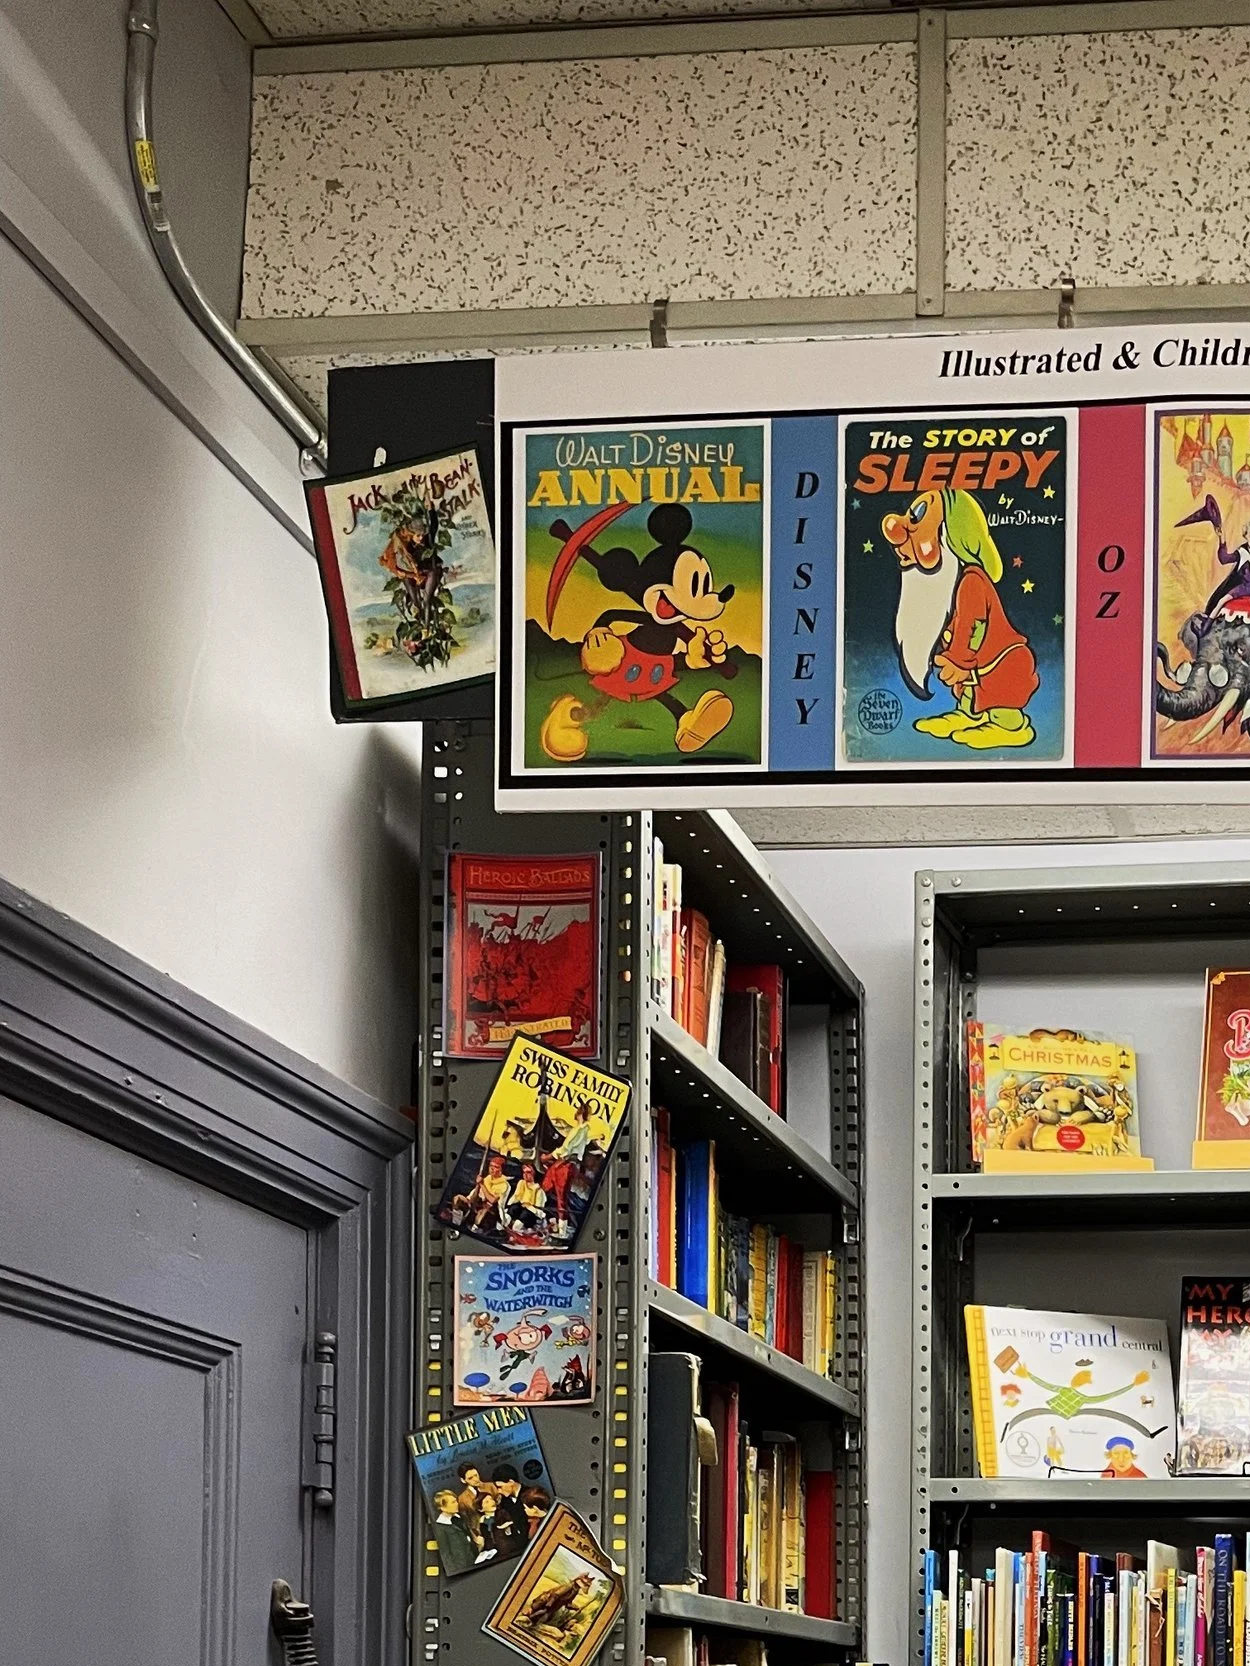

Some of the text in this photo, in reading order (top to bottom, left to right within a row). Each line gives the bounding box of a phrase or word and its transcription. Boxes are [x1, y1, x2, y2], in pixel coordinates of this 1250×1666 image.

[939, 343, 1101, 378] Illustrated
[1112, 342, 1141, 370] &
[555, 436, 624, 467] WALT
[869, 426, 1055, 449] The STORY of
[853, 450, 1060, 494] SLEEPY
[526, 466, 761, 508] ANNUAL
[998, 493, 1014, 509] by
[792, 471, 819, 725] DISNEY
[468, 864, 591, 889] HEROIC BALLADS
[1009, 1047, 1112, 1068] CHRISTMAS
[519, 1047, 624, 1104] SWISS FAMILY
[510, 1063, 616, 1124] ROBINSON
[484, 1266, 575, 1291] SNORKS
[1188, 1284, 1234, 1301] MY
[991, 1325, 1163, 1354] next stop grand central
[408, 1417, 479, 1457] LITTLE
[482, 1406, 528, 1436] MEN
[1218, 1549, 1228, 1567] ON
[1217, 1570, 1228, 1595] THE
[1217, 1599, 1228, 1634] ROAD
[1216, 1638, 1227, 1655] TO
